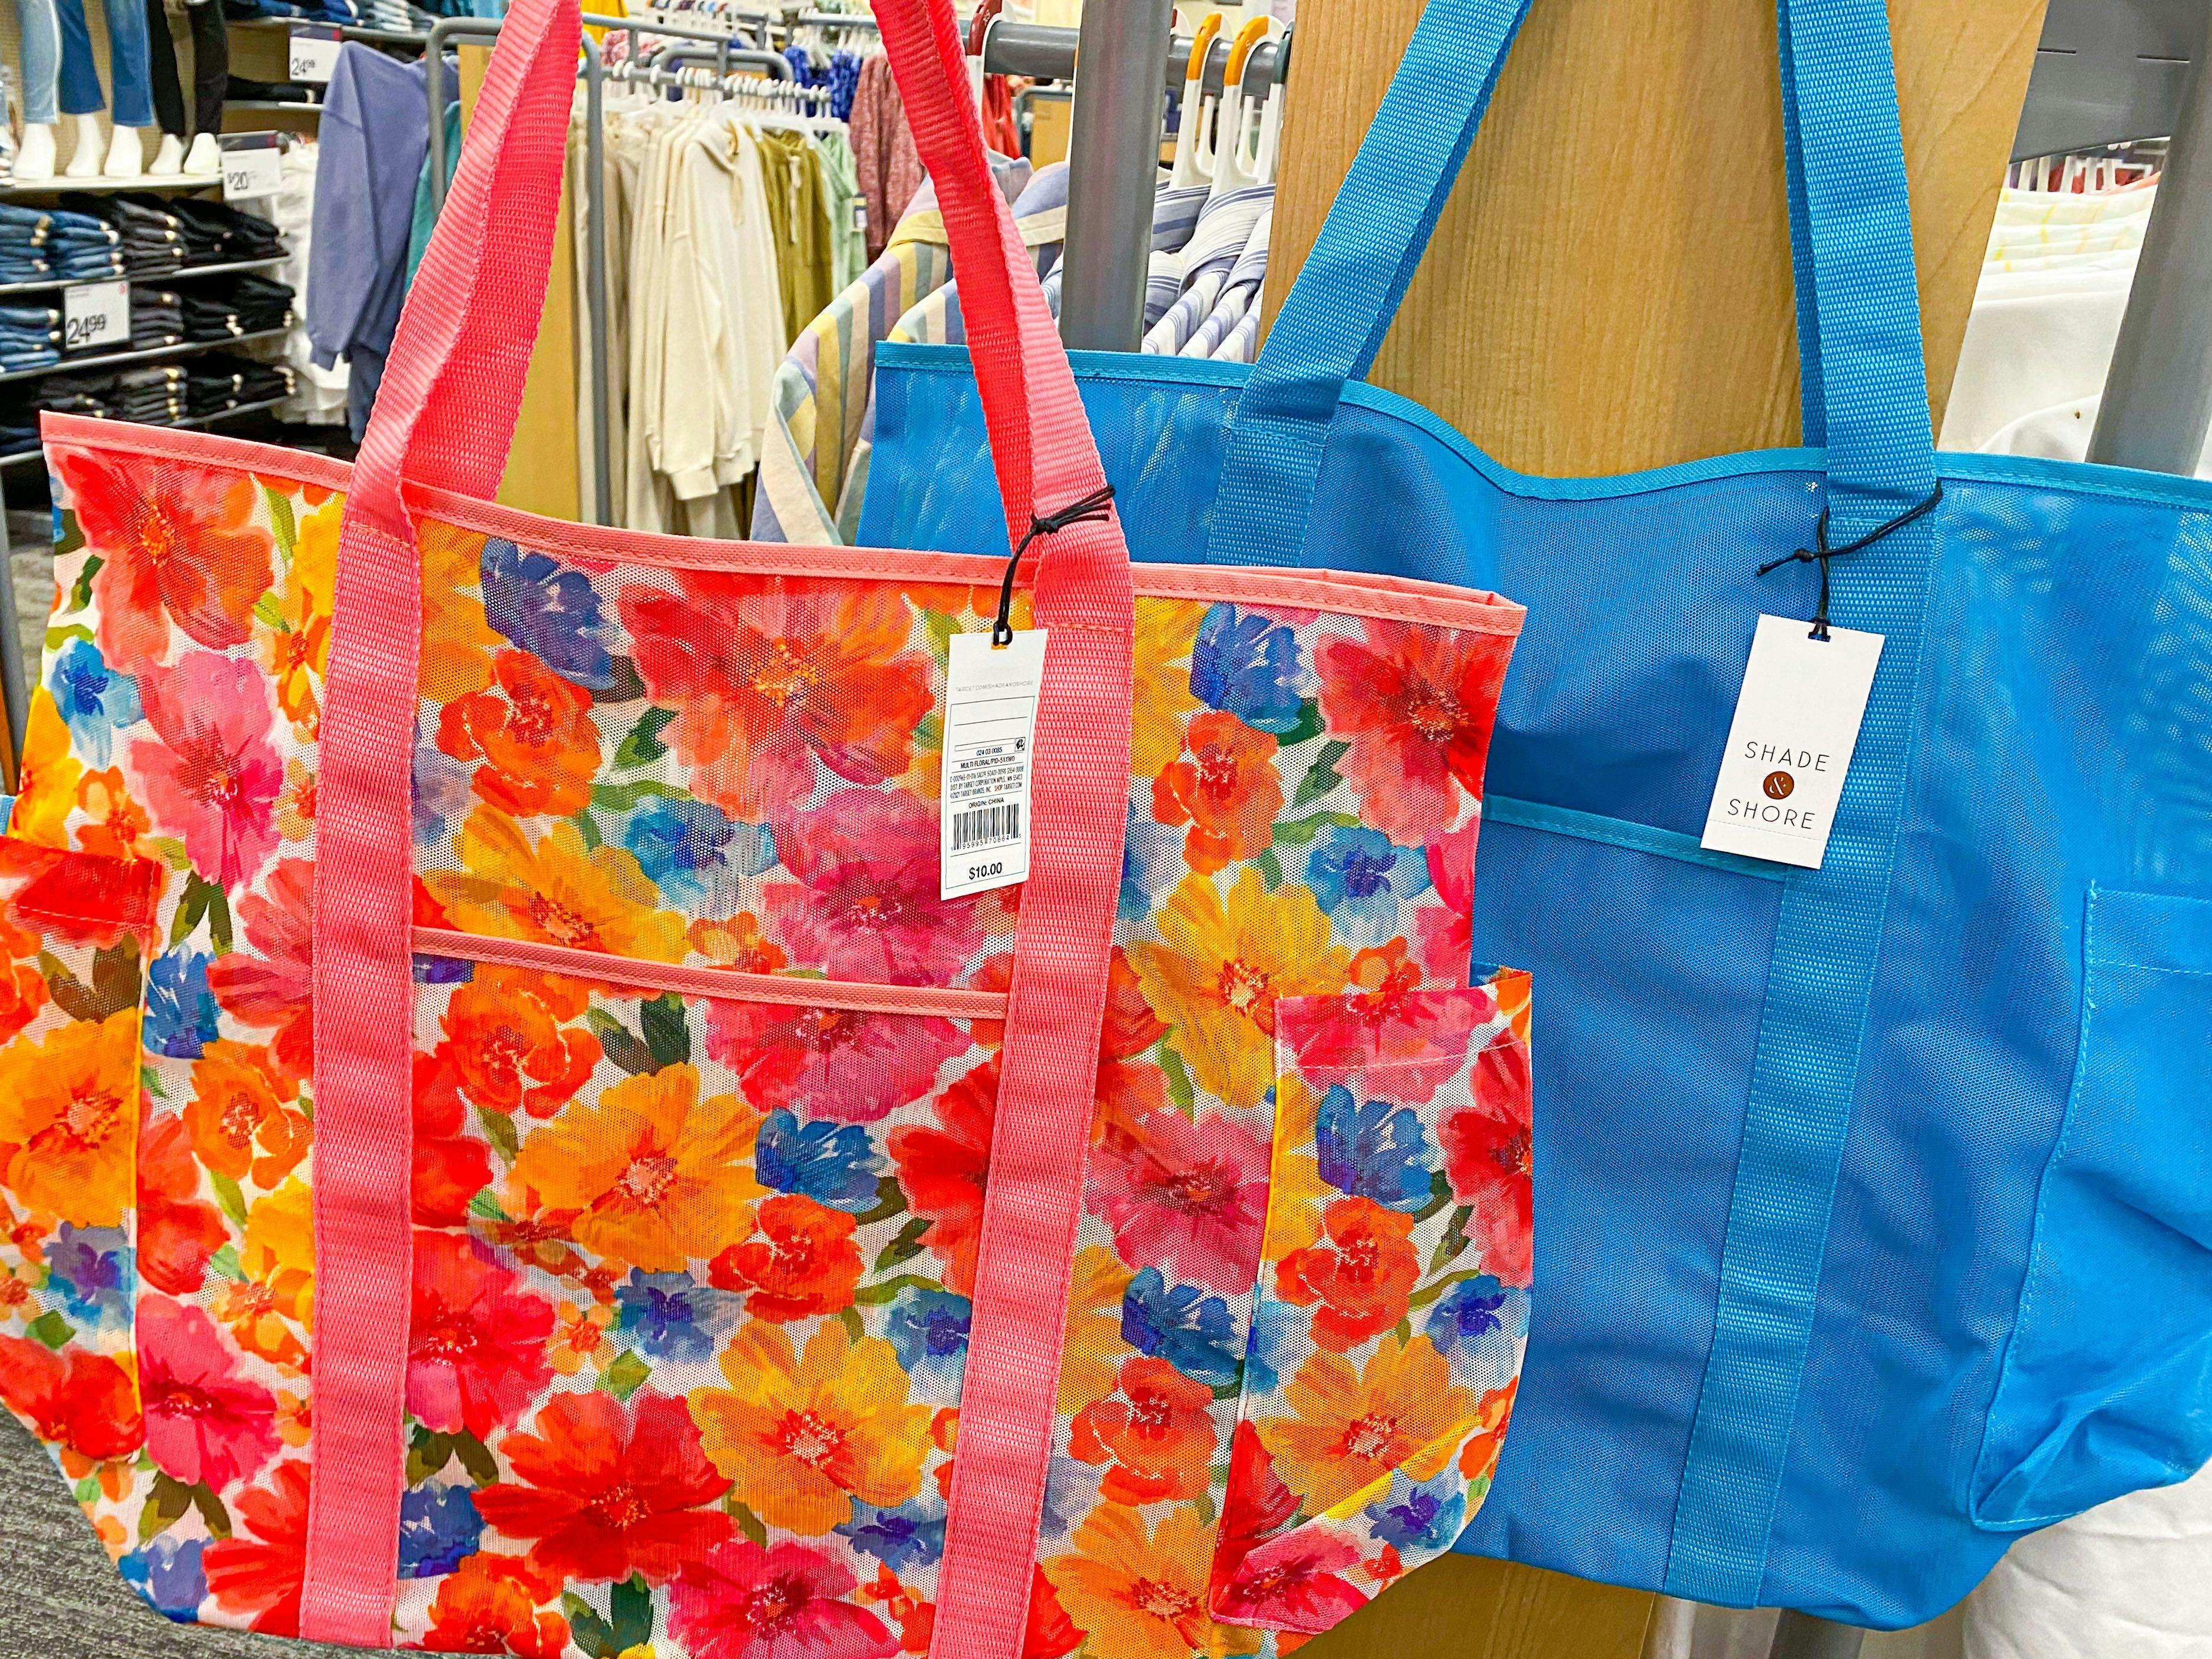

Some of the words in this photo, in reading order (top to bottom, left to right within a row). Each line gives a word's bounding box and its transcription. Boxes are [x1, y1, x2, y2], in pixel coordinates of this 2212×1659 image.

[1744, 741, 1830, 772] SHADE
[960, 761, 974, 769] MULTI
[964, 781, 975, 789] TARGET
[975, 777, 996, 787] CORPORATION
[968, 800, 987, 808] ORIGIN:
[988, 797, 1004, 805] CHINA
[1727, 798, 1816, 830] SHORE
[962, 839, 984, 850] 95995
[969, 862, 1002, 880] $10.00
